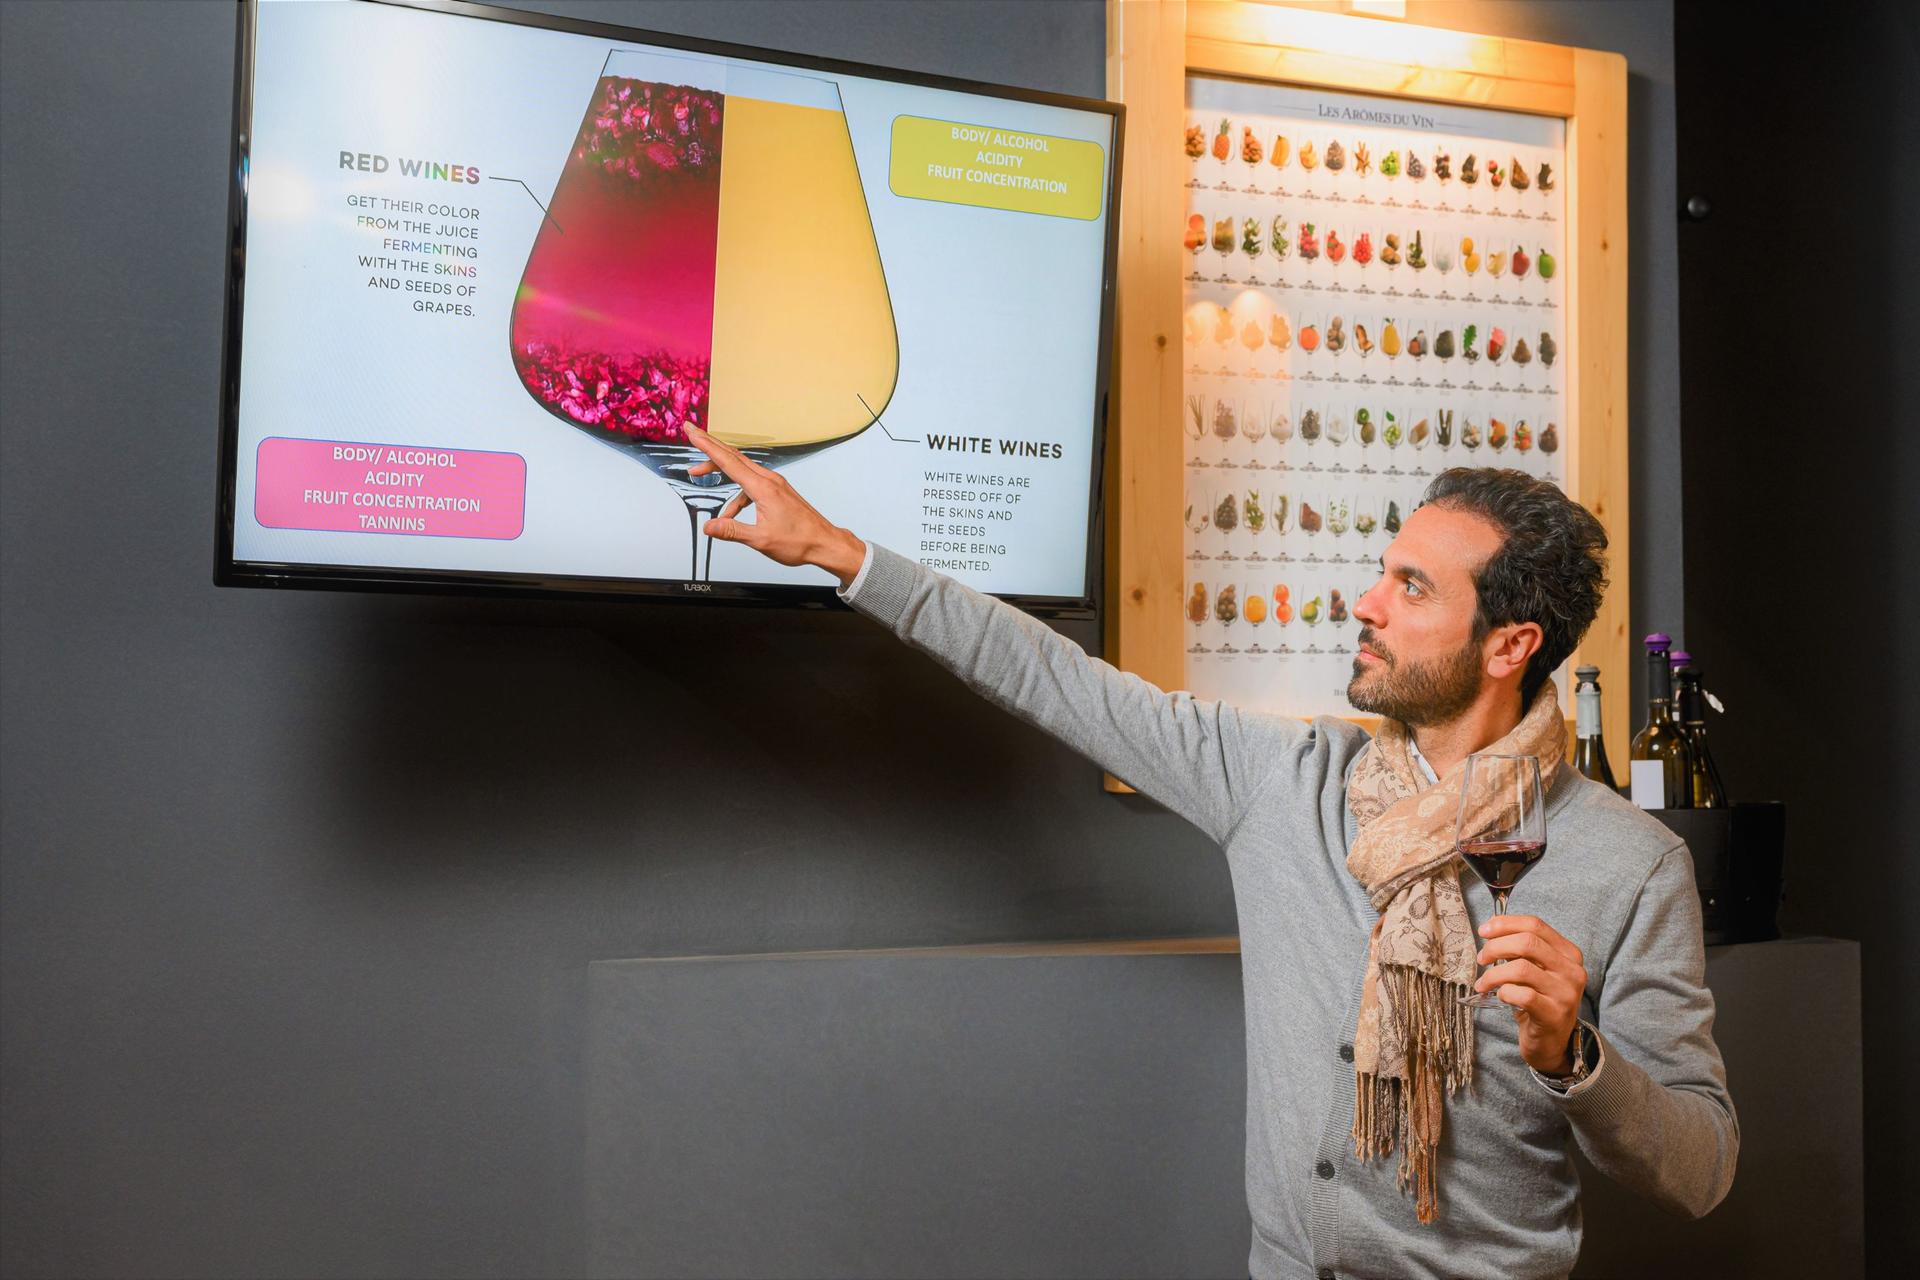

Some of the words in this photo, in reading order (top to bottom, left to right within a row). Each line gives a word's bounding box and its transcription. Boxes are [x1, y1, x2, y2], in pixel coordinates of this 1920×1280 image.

[951, 127, 990, 146] BODY/
[994, 134, 1049, 152] ALCOHOL
[339, 151, 389, 173] RED
[398, 158, 481, 185] WINES
[976, 151, 1023, 168] ACIDITY
[927, 164, 963, 180] FRUIT
[966, 169, 1068, 194] CONCENTRATION
[347, 195, 377, 209] GET
[381, 198, 423, 214] THEIR
[428, 204, 480, 220] COLOR
[357, 216, 399, 231] FROM
[403, 221, 431, 235] THE
[435, 224, 479, 240] JUICE
[383, 238, 478, 259] FERMENTING
[358, 255, 397, 270] WITH
[401, 259, 429, 274] THE
[434, 263, 477, 278] SKINS
[368, 276, 400, 290] AND
[405, 280, 452, 295] SEEDS
[456, 284, 477, 297] OF
[413, 300, 476, 317] GRAPES.
[333, 446, 384, 465] BODY/
[386, 450, 457, 468] ALCOHOL
[926, 434, 992, 454] WHITE
[999, 439, 1063, 459] WINES
[364, 470, 425, 487] ACIDITY
[924, 471, 963, 484] WHITE
[966, 474, 1004, 487] WINES
[1007, 477, 1031, 488] ARE
[303, 489, 349, 506] FRUIT
[352, 492, 481, 513] CONCENTRATION
[923, 488, 976, 502] PRESSED
[979, 492, 1002, 503] OFF
[1005, 494, 1021, 504] OF
[358, 514, 426, 531] TANNINS
[922, 505, 945, 517] THE
[949, 507, 984, 520] SKINS
[987, 510, 1013, 521] AND
[921, 523, 944, 535] THE
[948, 524, 986, 537] SEEDS
[920, 540, 967, 553] BEFORE
[970, 543, 1007, 555] BEING
